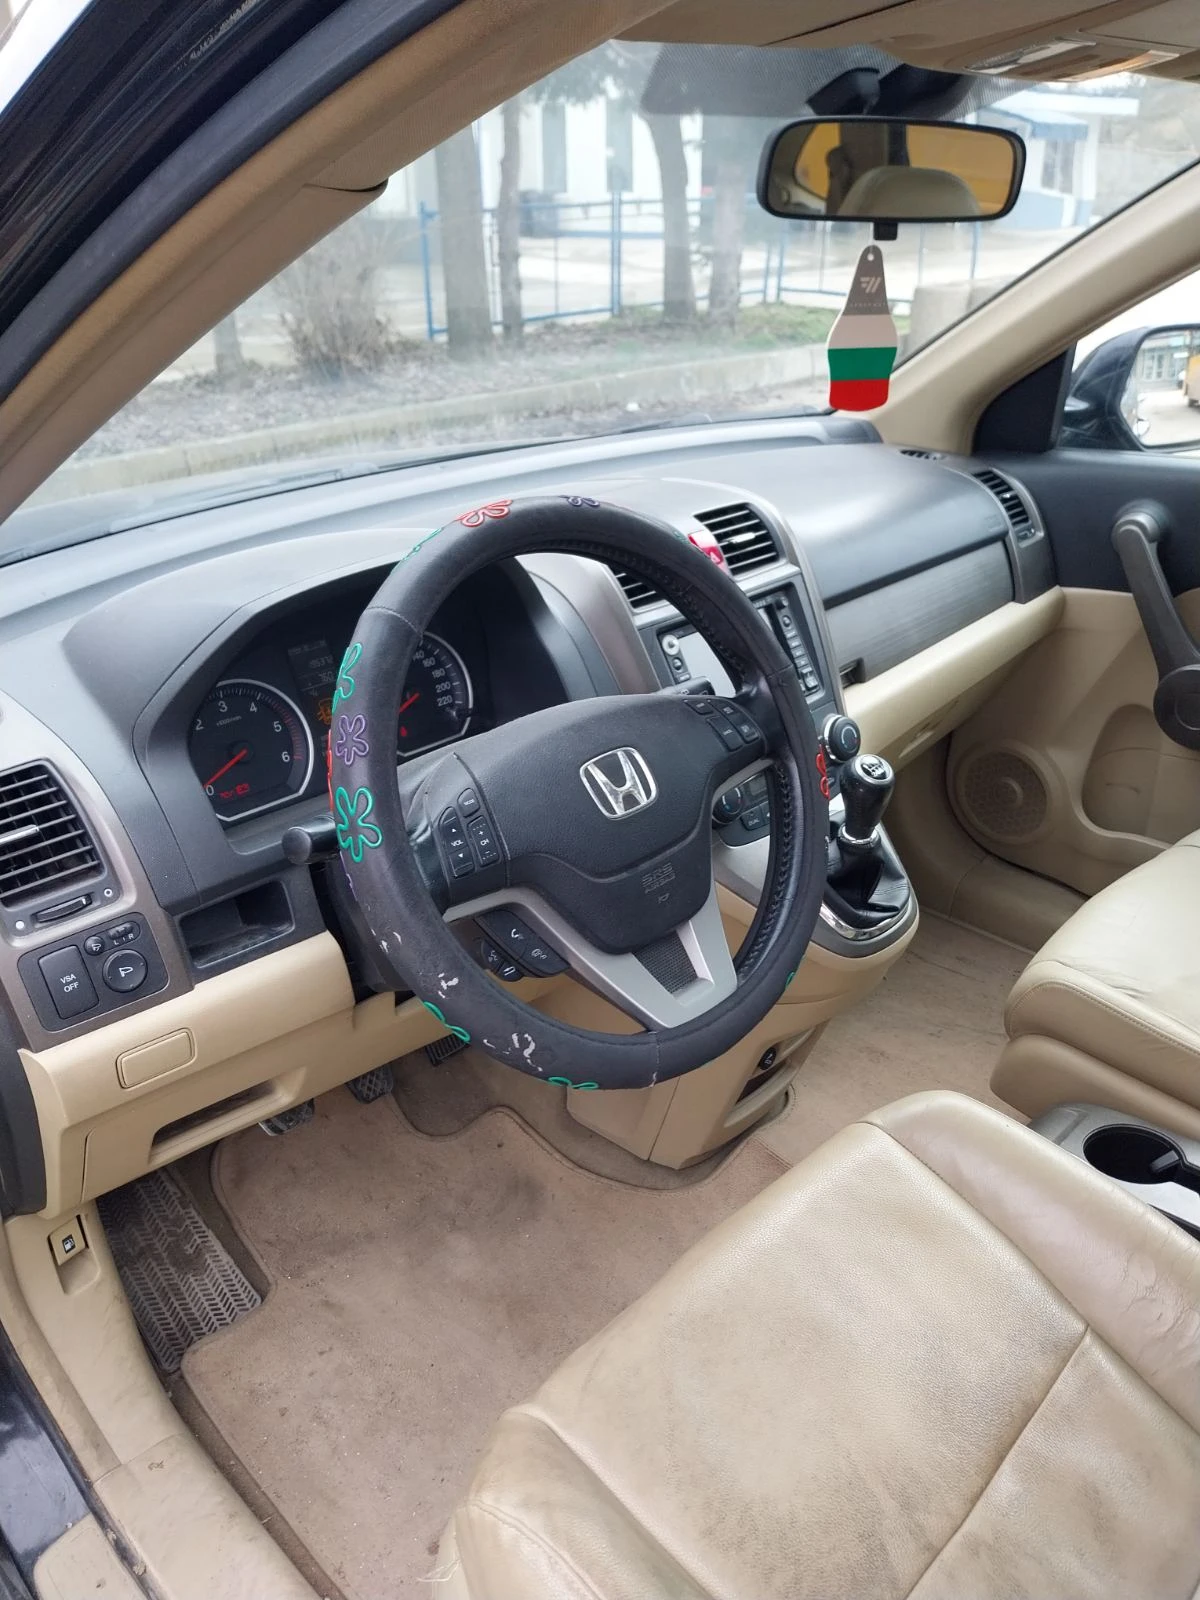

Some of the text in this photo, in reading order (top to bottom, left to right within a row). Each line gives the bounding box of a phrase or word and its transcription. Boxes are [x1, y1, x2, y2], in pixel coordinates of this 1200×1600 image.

[435, 681, 450, 693] 200
[437, 695, 452, 706] 220
[218, 701, 228, 712] 3
[249, 702, 257, 712] 4
[195, 719, 204, 730] 2
[273, 720, 282, 732] 5
[281, 751, 290, 762] 6
[206, 784, 214, 796] 0
[450, 839, 464, 847] VOL
[60, 973, 76, 983] VSA
[64, 982, 79, 992] OFF
